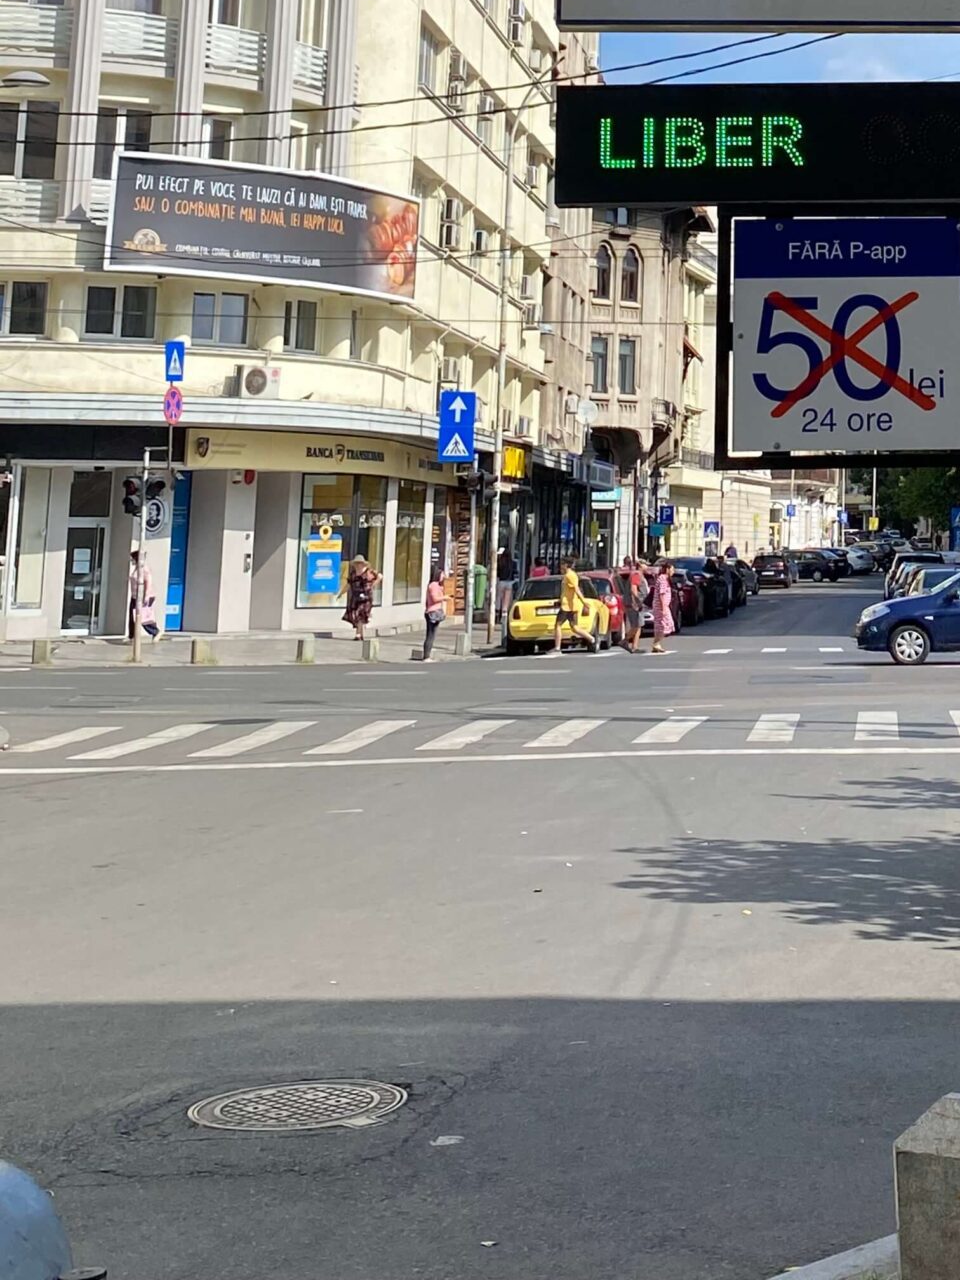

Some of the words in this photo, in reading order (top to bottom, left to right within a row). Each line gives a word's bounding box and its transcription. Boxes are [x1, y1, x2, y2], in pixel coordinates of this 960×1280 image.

[599, 116, 805, 169] LIBER
[135, 173, 154, 190] PUI
[159, 175, 190, 193] EFECT
[193, 179, 205, 195] PE
[241, 185, 253, 200] TE
[257, 186, 281, 204] LAUZI
[284, 187, 296, 207] CĂ
[298, 191, 307, 208] AI
[161, 198, 170, 213] O
[240, 206, 256, 223] MAI
[788, 238, 844, 261] FĂRĂ
[850, 243, 907, 264] P-app
[752, 293, 902, 402] 50
[909, 368, 946, 400] lei
[801, 409, 843, 433] 24
[849, 413, 894, 433] ore
[306, 446, 334, 459] BANCA
